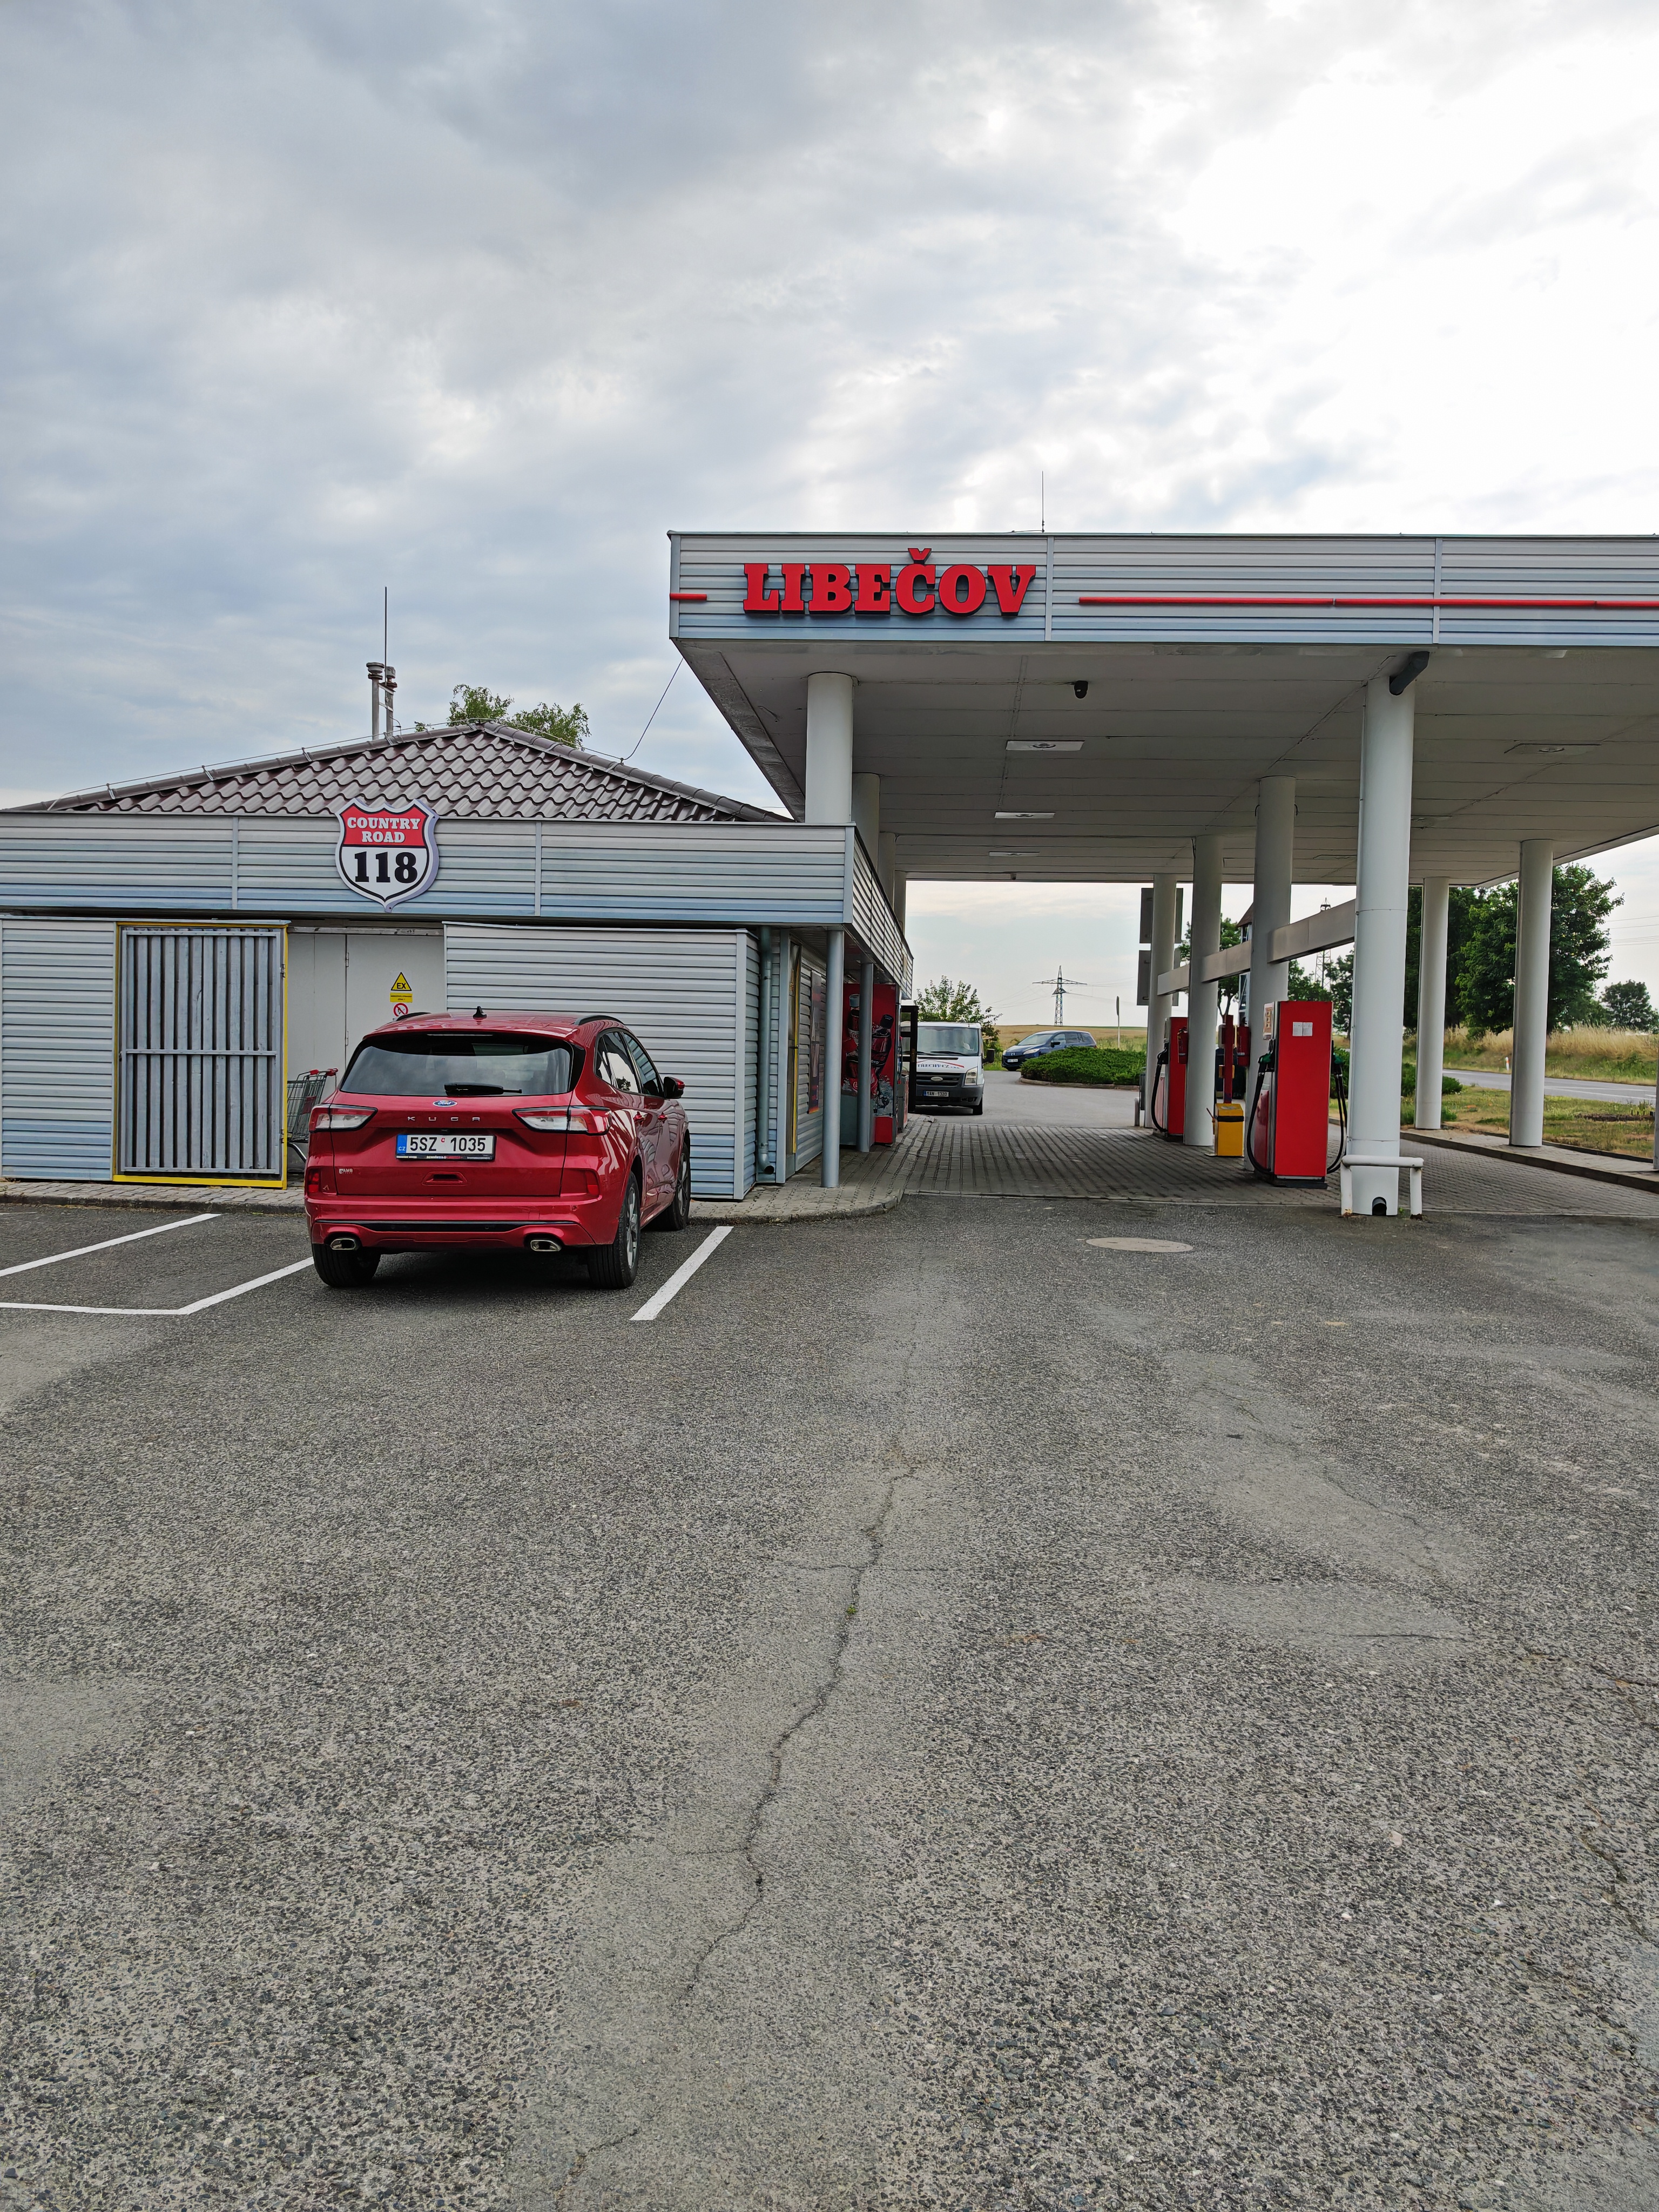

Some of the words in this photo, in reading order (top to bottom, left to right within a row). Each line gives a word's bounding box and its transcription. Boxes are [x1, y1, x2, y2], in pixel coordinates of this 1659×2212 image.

[743, 548, 1036, 617] LIBEČOV
[347, 817, 420, 830] COUNTRY
[362, 831, 405, 843] ROAD
[354, 851, 417, 883] 118
[410, 1137, 437, 1151] 5SZ
[450, 1137, 486, 1152] 1035
